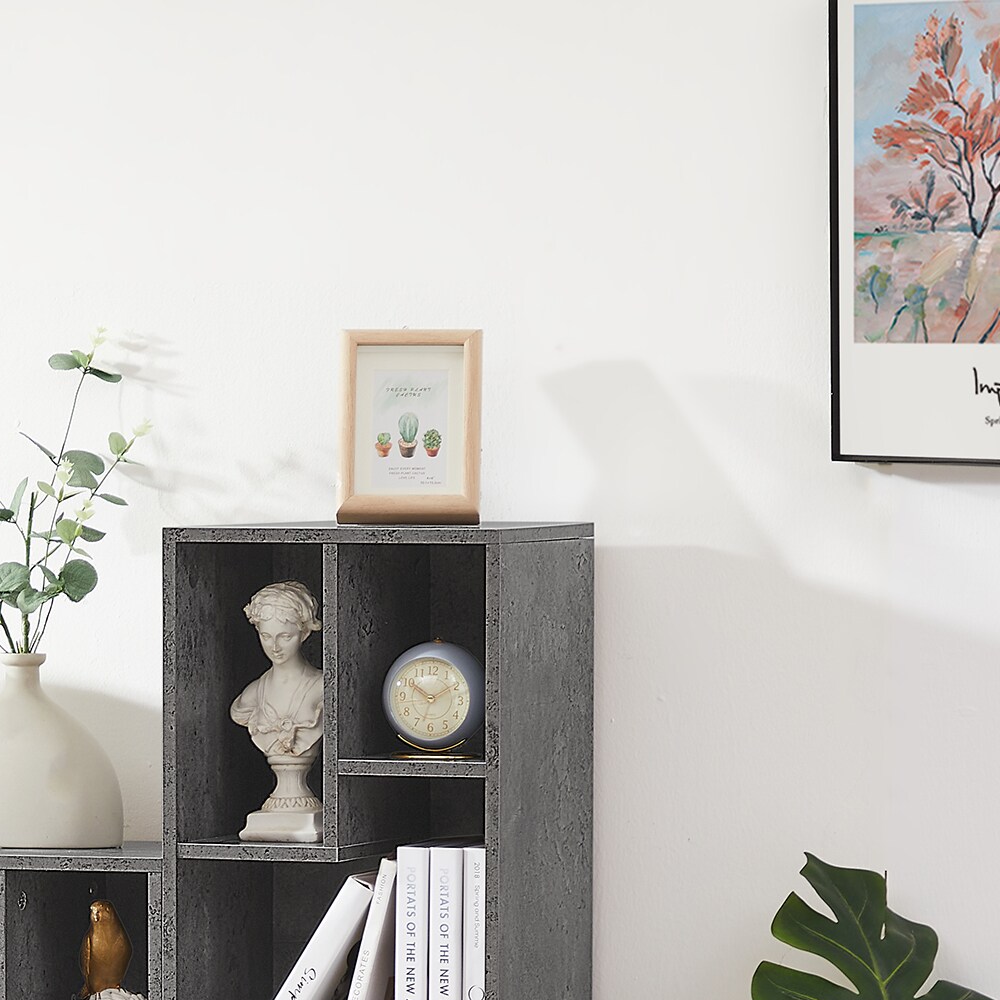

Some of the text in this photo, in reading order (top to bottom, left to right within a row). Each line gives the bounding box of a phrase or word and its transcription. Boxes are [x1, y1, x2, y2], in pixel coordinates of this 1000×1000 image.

[415, 669, 424, 678] 11
[428, 666, 439, 675] 12
[403, 678, 414, 687] 10
[453, 682, 460, 691] 2
[400, 692, 406, 701] 9
[457, 696, 464, 705] 3
[403, 707, 410, 716] 8
[452, 710, 459, 719] 4
[414, 717, 420, 727] 7
[442, 720, 449, 730] 5
[427, 723, 434, 732] 6
[472, 862, 480, 879] 2018
[406, 866, 417, 917] PORTATS
[439, 868, 450, 919] PORTATS
[406, 921, 416, 938] OF
[439, 923, 450, 940] OF
[406, 942, 416, 963] THE
[439, 944, 450, 965] THE
[405, 967, 416, 995] NEW
[439, 969, 450, 997] NEW
